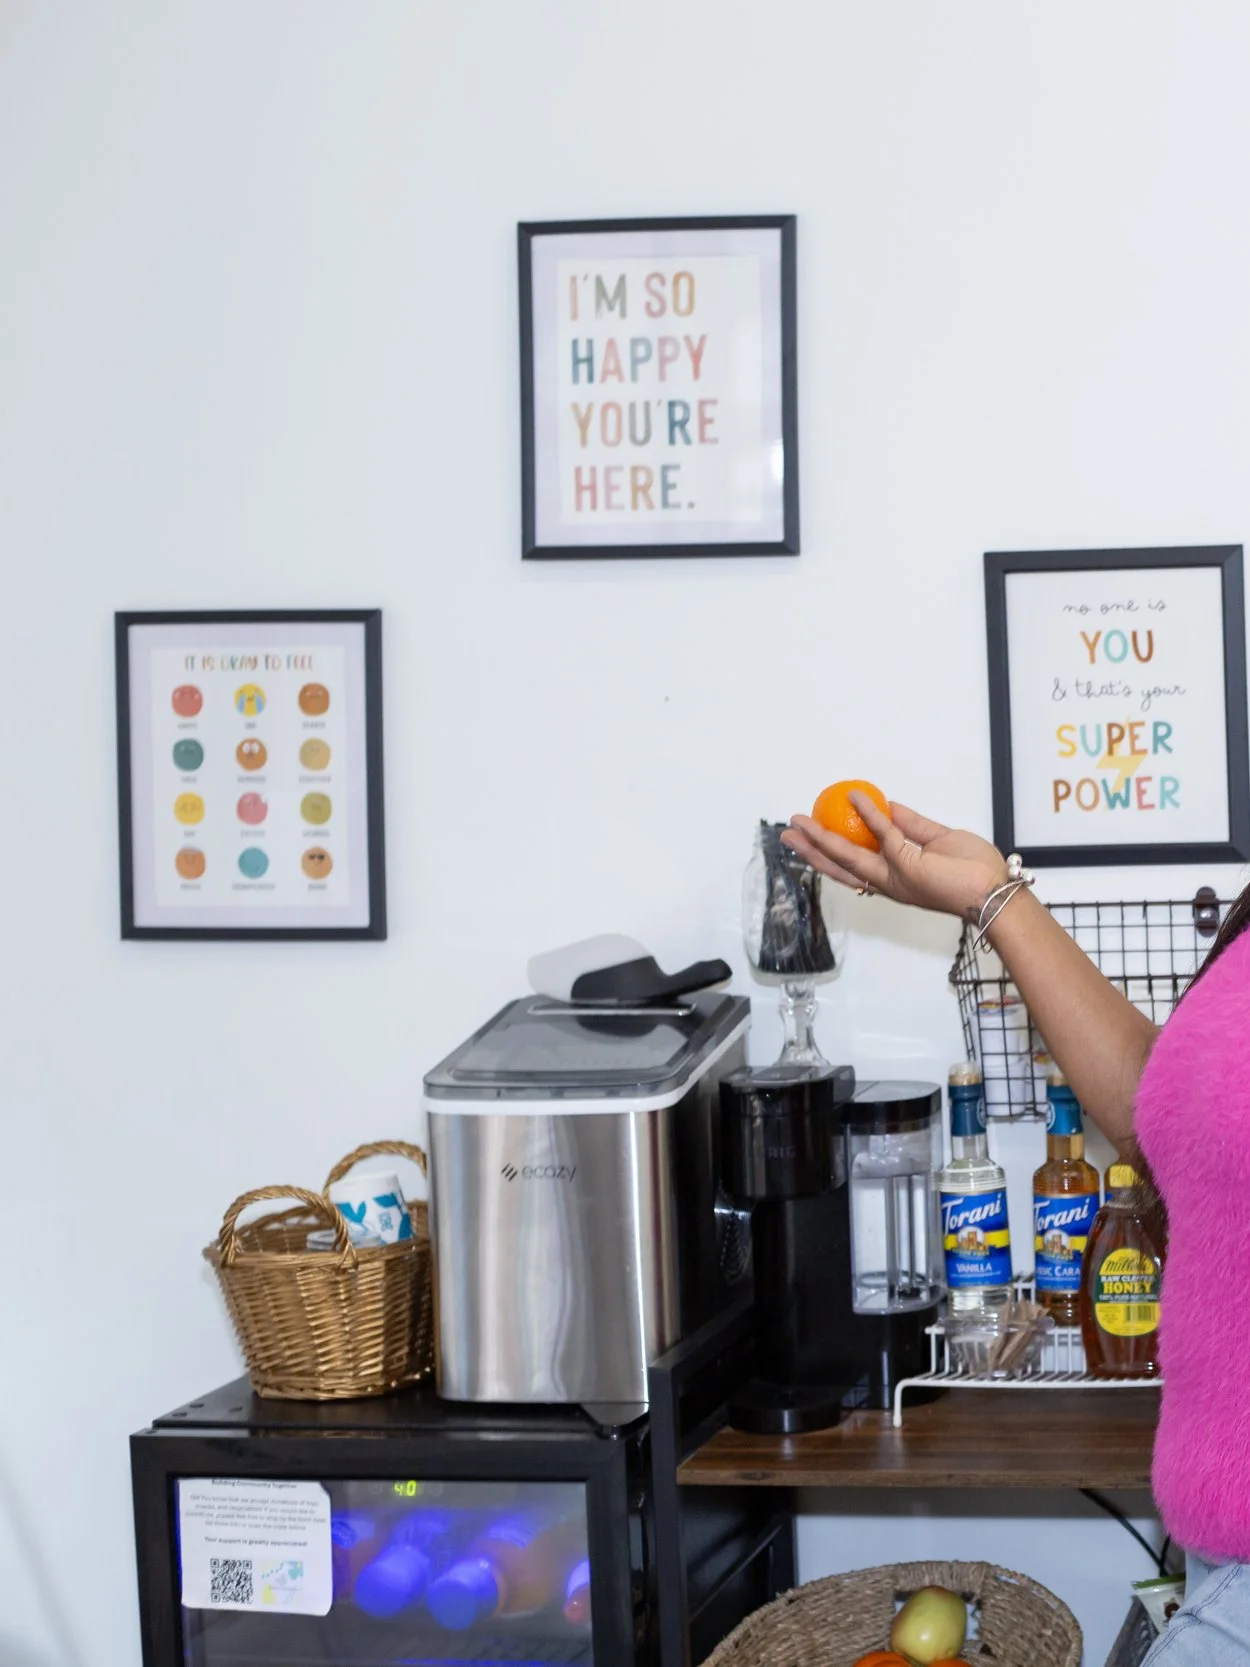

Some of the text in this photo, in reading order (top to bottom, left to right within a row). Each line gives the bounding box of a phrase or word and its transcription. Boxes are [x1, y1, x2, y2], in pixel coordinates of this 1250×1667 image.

[569, 270, 696, 321] I'M SO
[570, 334, 708, 385] HAPPY
[570, 398, 720, 448] YOU'RE
[573, 464, 696, 513] HERE.
[1062, 599, 1167, 615] no one is
[185, 654, 313, 671] IT IS OKAY TO FEEL
[1080, 629, 1155, 665] YOU
[1052, 677, 1187, 712] & that's your
[1055, 720, 1174, 759] SUPER
[1053, 775, 1181, 813] POWER
[522, 1165, 577, 1183] ecozy
[941, 1193, 1002, 1235] Torani
[1034, 1197, 1090, 1237] Torani
[956, 1263, 993, 1273] VANILLA
[1054, 1265, 1080, 1277] CARA
[1101, 1275, 1120, 1283] RAW
[1103, 1282, 1153, 1294] HONEY
[394, 1480, 417, 1496] 40
[218, 1537, 242, 1546] support
